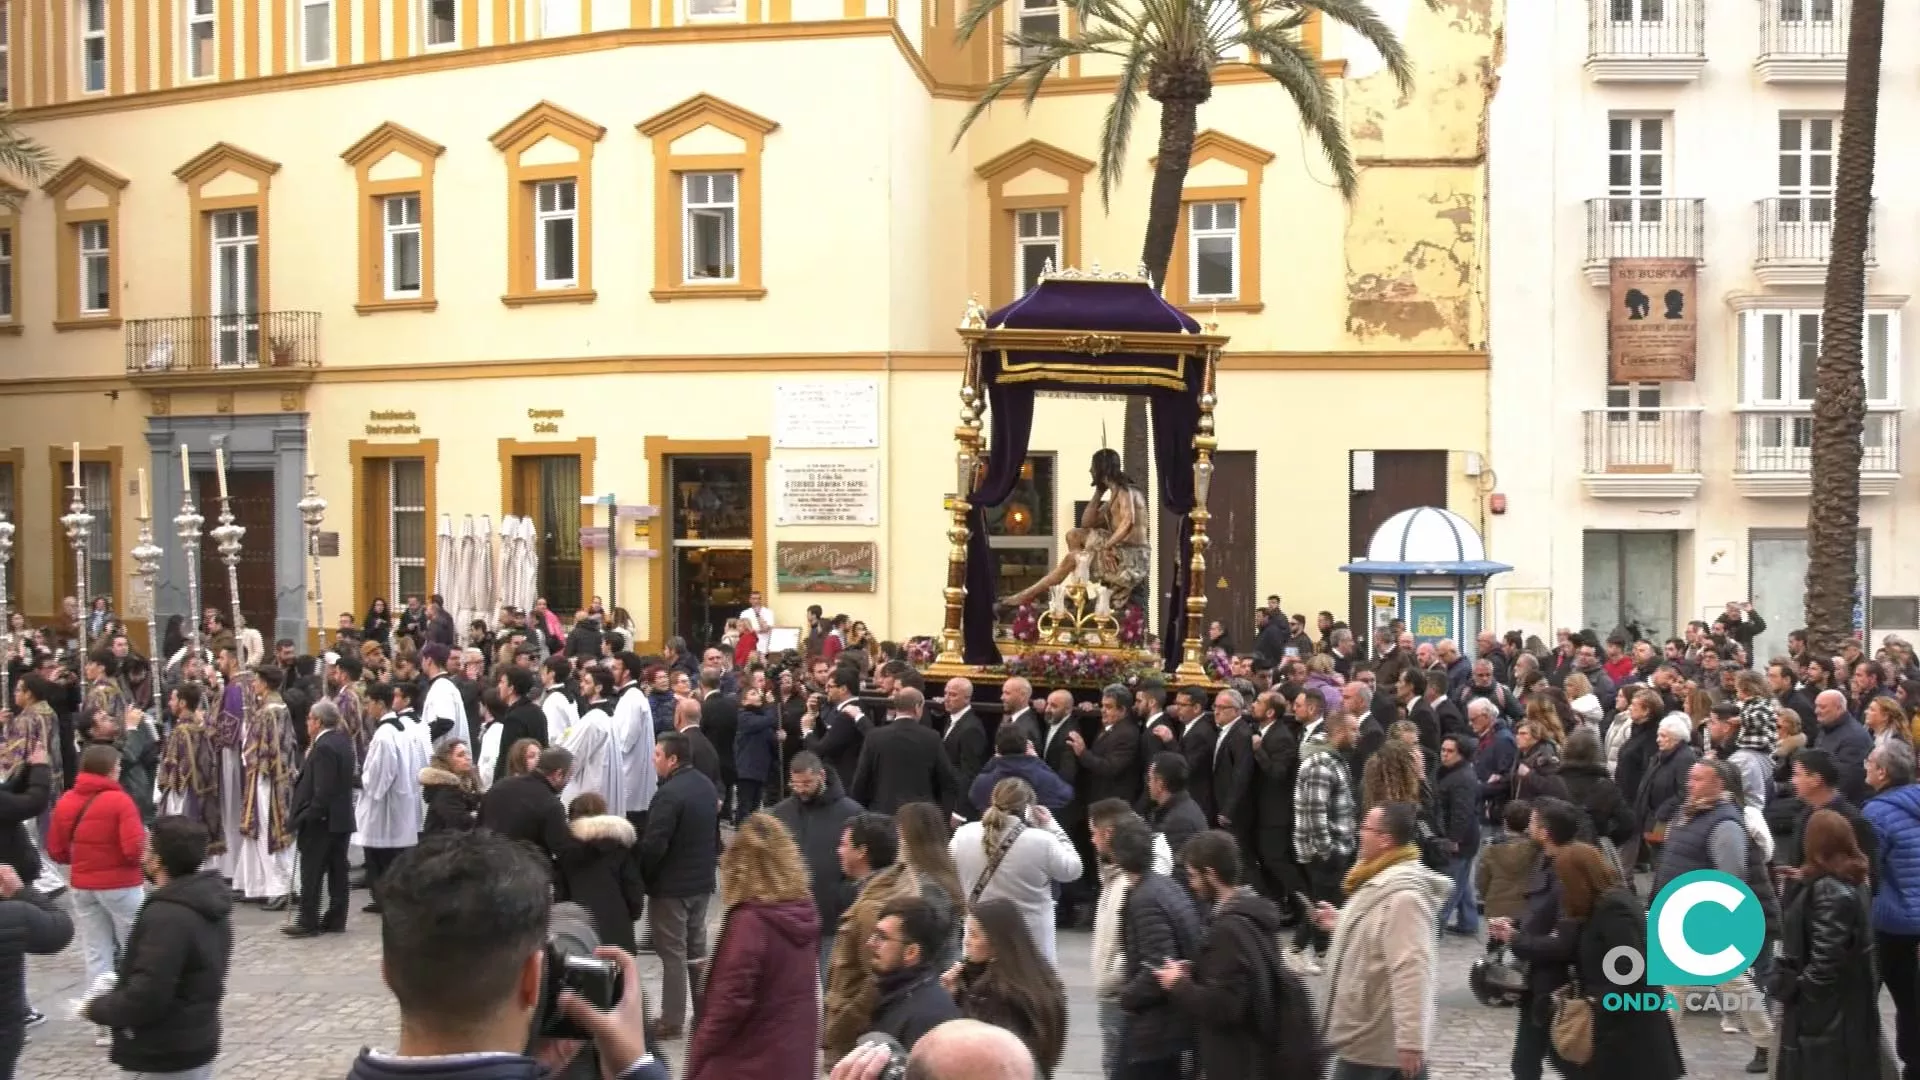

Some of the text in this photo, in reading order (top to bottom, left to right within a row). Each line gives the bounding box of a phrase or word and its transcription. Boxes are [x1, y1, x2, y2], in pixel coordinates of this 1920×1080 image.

[369, 409, 416, 421] Residencia
[528, 408, 564, 420] Campus
[365, 423, 421, 435] Universitaria
[533, 421, 558, 433] Cádiz
